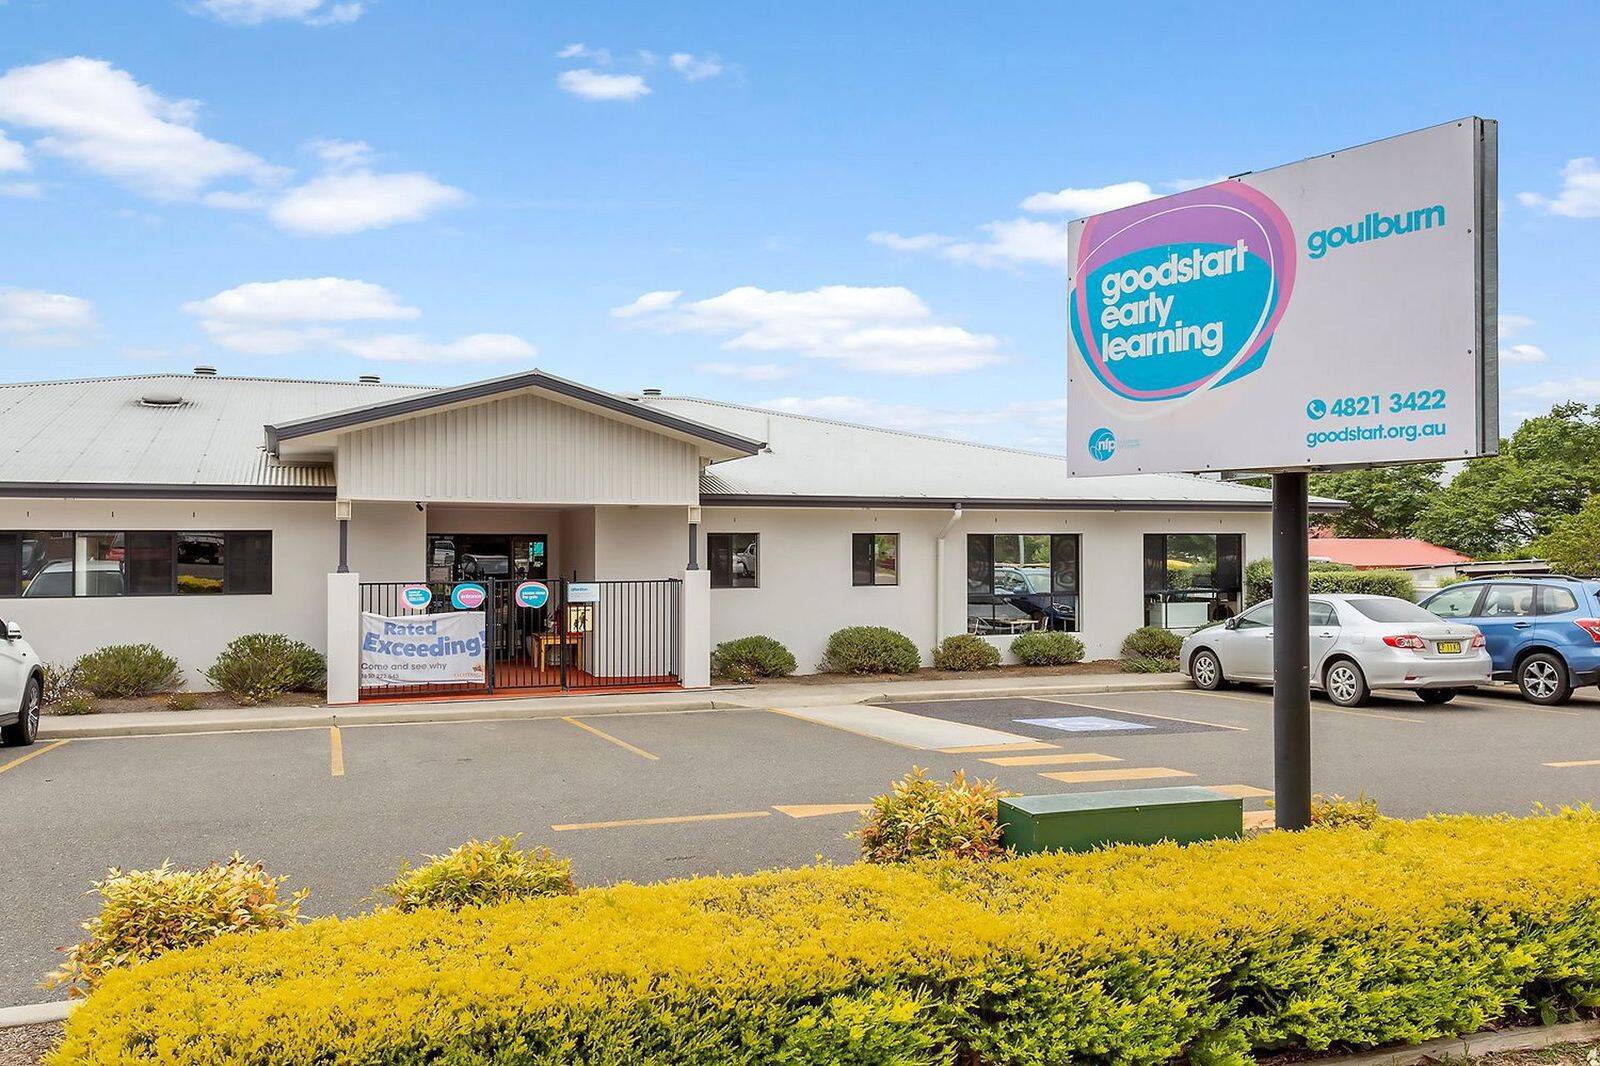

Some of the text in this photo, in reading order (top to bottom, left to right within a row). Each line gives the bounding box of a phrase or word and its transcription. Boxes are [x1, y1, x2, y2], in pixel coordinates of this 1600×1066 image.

[1307, 203, 1446, 260] goulburn
[1101, 239, 1249, 305] goodstart
[1101, 292, 1175, 330] early
[1102, 320, 1223, 362] learning
[1330, 389, 1447, 417] 4821 3422
[1306, 421, 1447, 448] goodstart.org.au
[383, 620, 437, 636] Rated
[363, 630, 486, 657] Exceeding!
[361, 662, 389, 671] Come
[391, 662, 409, 670] and
[429, 662, 448, 672] why
